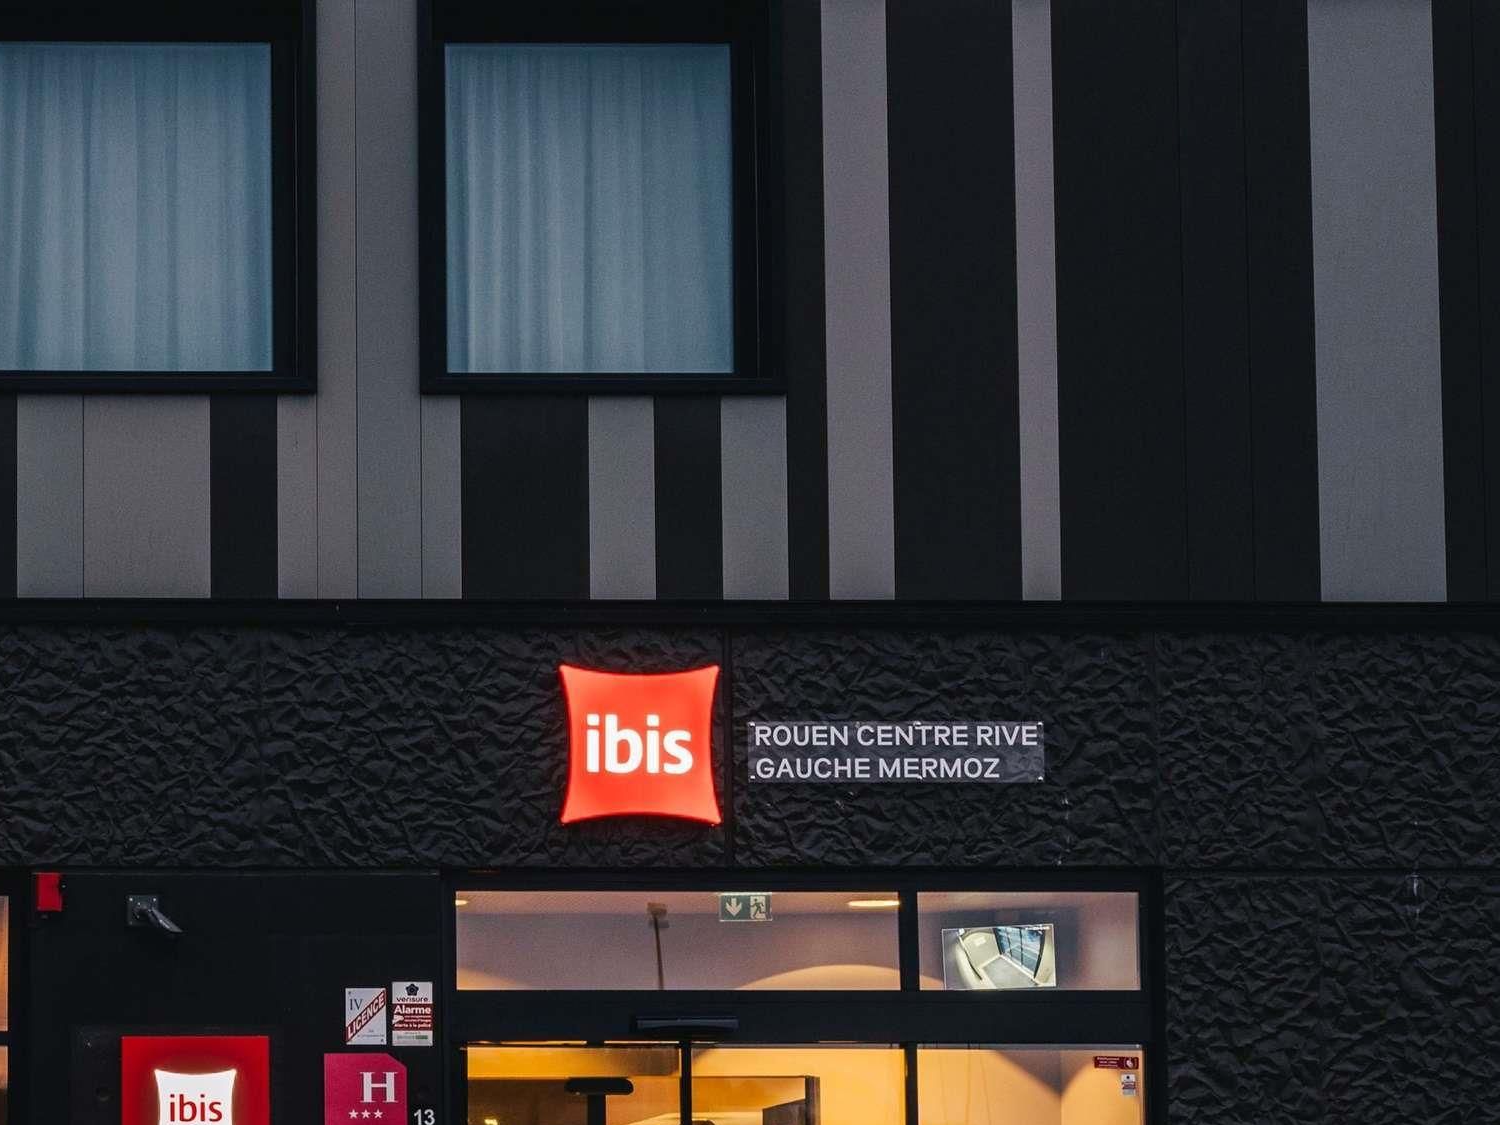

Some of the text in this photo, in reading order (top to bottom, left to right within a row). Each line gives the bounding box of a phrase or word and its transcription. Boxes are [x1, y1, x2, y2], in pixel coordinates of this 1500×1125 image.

[586, 713, 694, 775] ibis
[755, 725, 1038, 746] ROUEN CENTRE RIVE
[756, 757, 1000, 779] GAUCHE MERMOZ
[350, 999, 362, 1010] IV
[394, 1005, 431, 1014] Alarme
[347, 992, 385, 1040] LICENCE
[359, 1072, 398, 1103] H
[170, 1094, 222, 1122] ibis
[414, 1109, 435, 1125] 13
